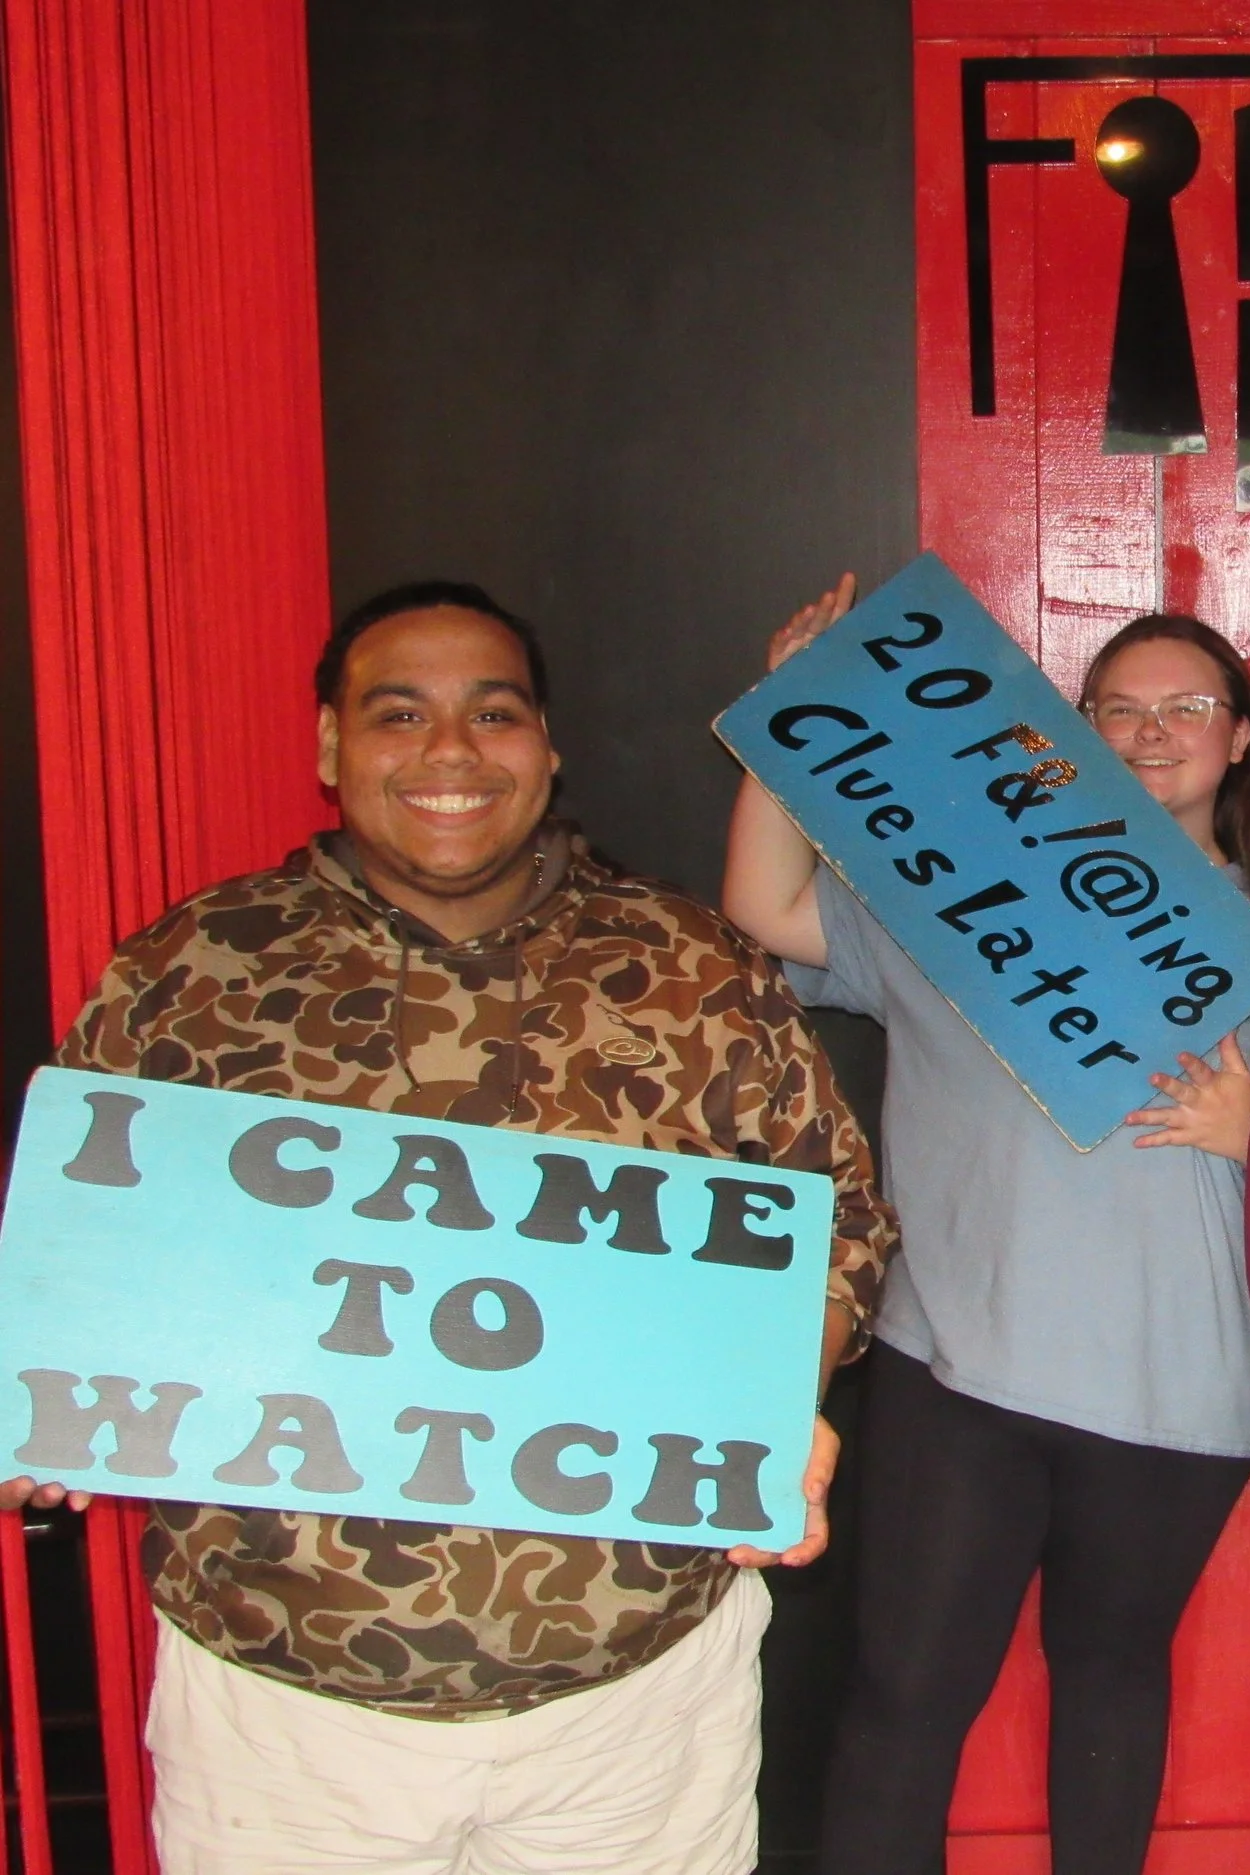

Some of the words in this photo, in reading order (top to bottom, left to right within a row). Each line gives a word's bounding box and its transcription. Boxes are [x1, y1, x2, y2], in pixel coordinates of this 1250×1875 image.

[862, 611, 993, 709] 20
[768, 703, 956, 886] Clues
[935, 880, 1140, 1068] Later
[62, 1092, 146, 1187] I
[228, 1116, 796, 1271] CAME
[313, 1258, 545, 1371] TO
[14, 1368, 774, 1532] WATCH
